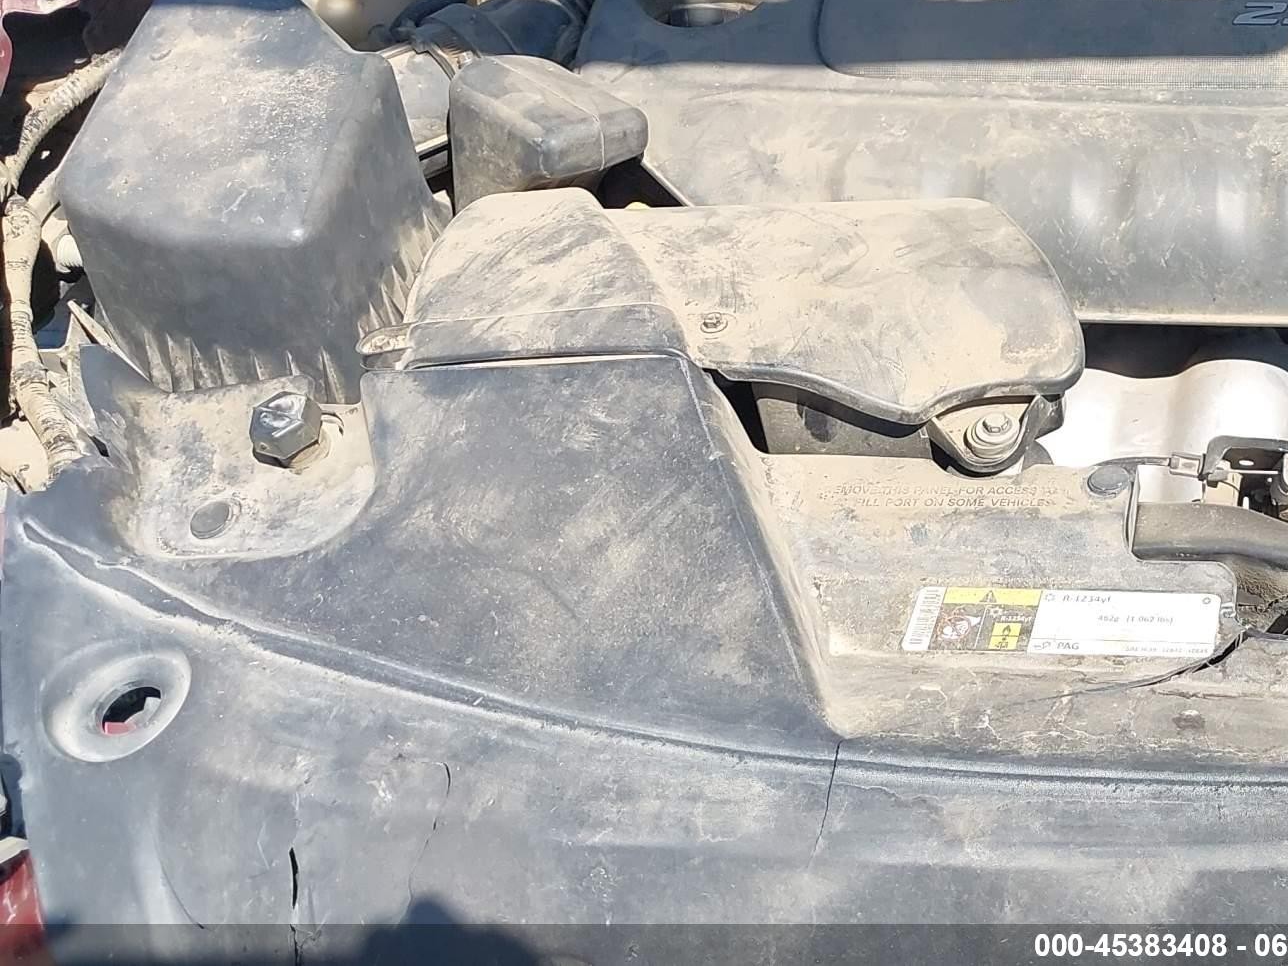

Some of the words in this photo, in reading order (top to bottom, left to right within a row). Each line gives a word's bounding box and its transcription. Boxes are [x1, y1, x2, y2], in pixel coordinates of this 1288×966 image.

[833, 485, 882, 495] EMOVE
[958, 486, 984, 495] FOR
[987, 486, 1037, 495] ACCESS
[885, 498, 920, 507] PORT
[924, 498, 944, 507] ON
[947, 498, 985, 507] SOME
[991, 498, 1057, 507] VEHICLES
[1056, 641, 1080, 650] PAG
